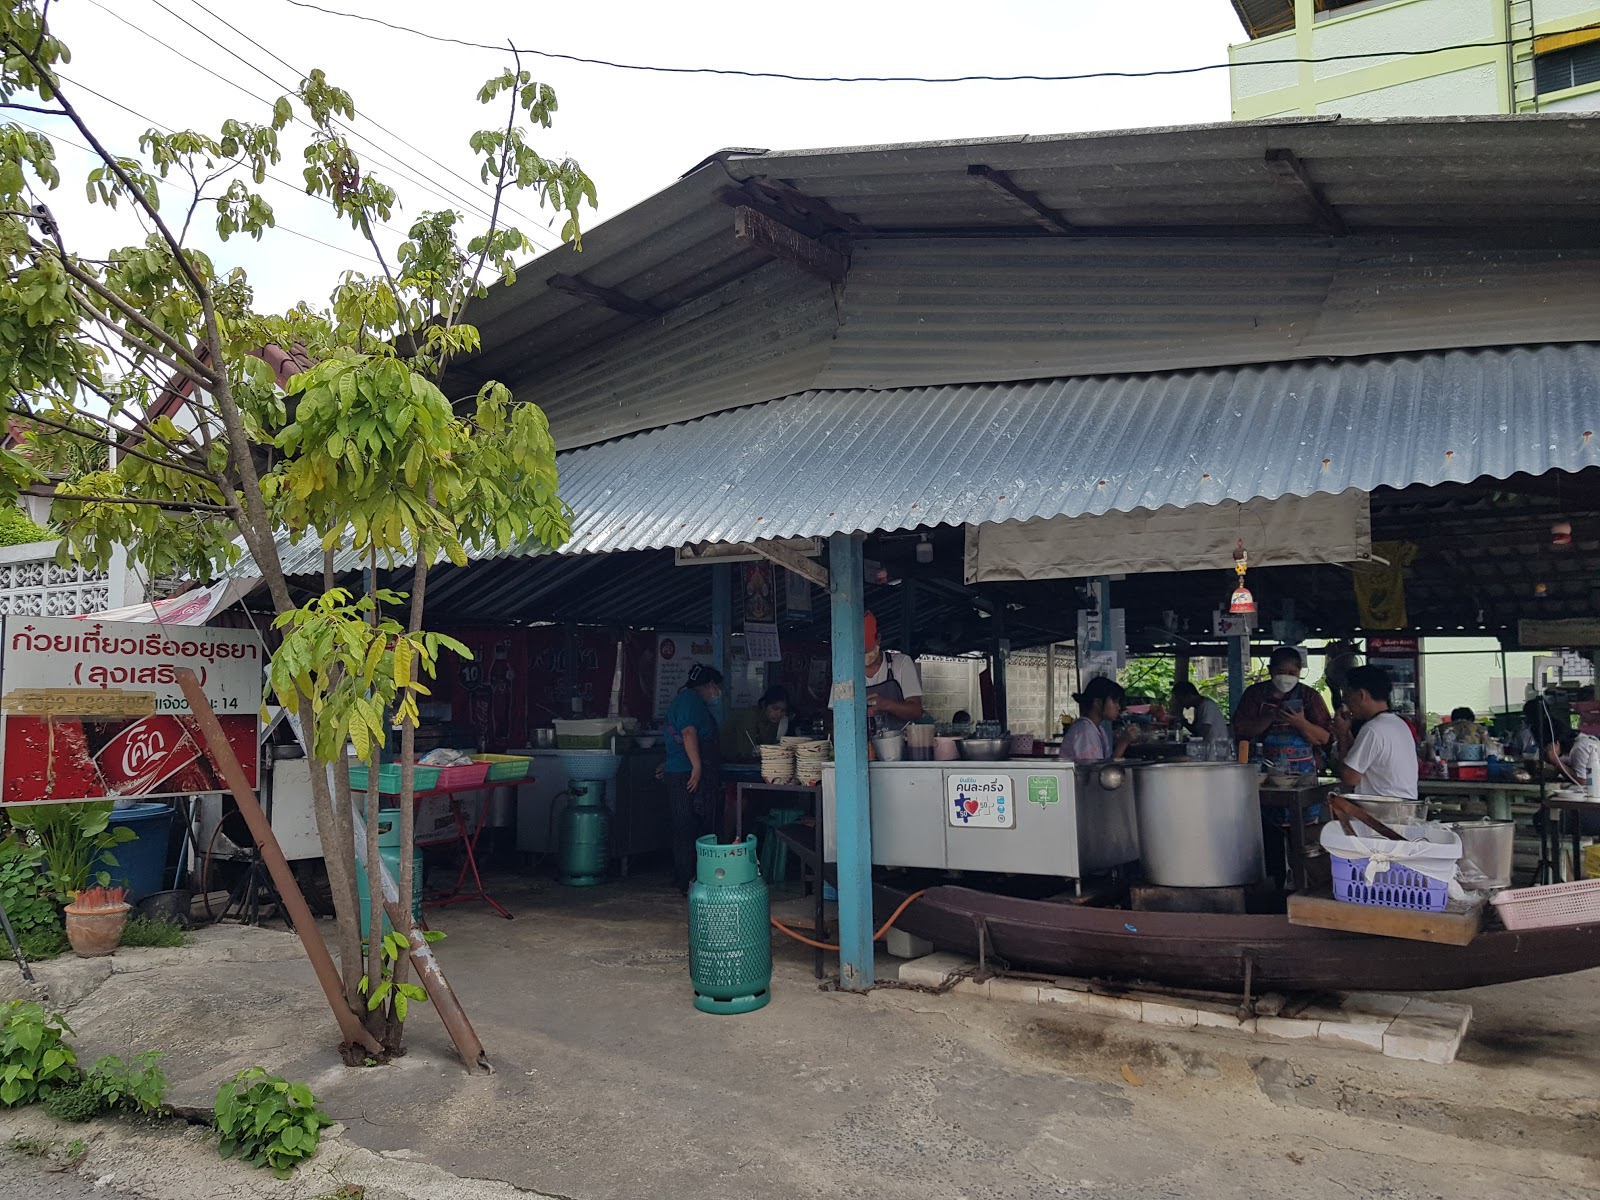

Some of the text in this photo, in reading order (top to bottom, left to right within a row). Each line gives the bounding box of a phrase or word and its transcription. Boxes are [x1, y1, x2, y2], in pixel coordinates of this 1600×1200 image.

[12, 624, 257, 664] ก๋วยเตี๋ยวเรืออยุธยา
[74, 662, 207, 689] (ลุงเสริ)
[155, 694, 218, 709] แจ้งวะ
[222, 697, 238, 709] 14
[956, 778, 1004, 792] คนละครึ่ง
[959, 810, 968, 818] 50
